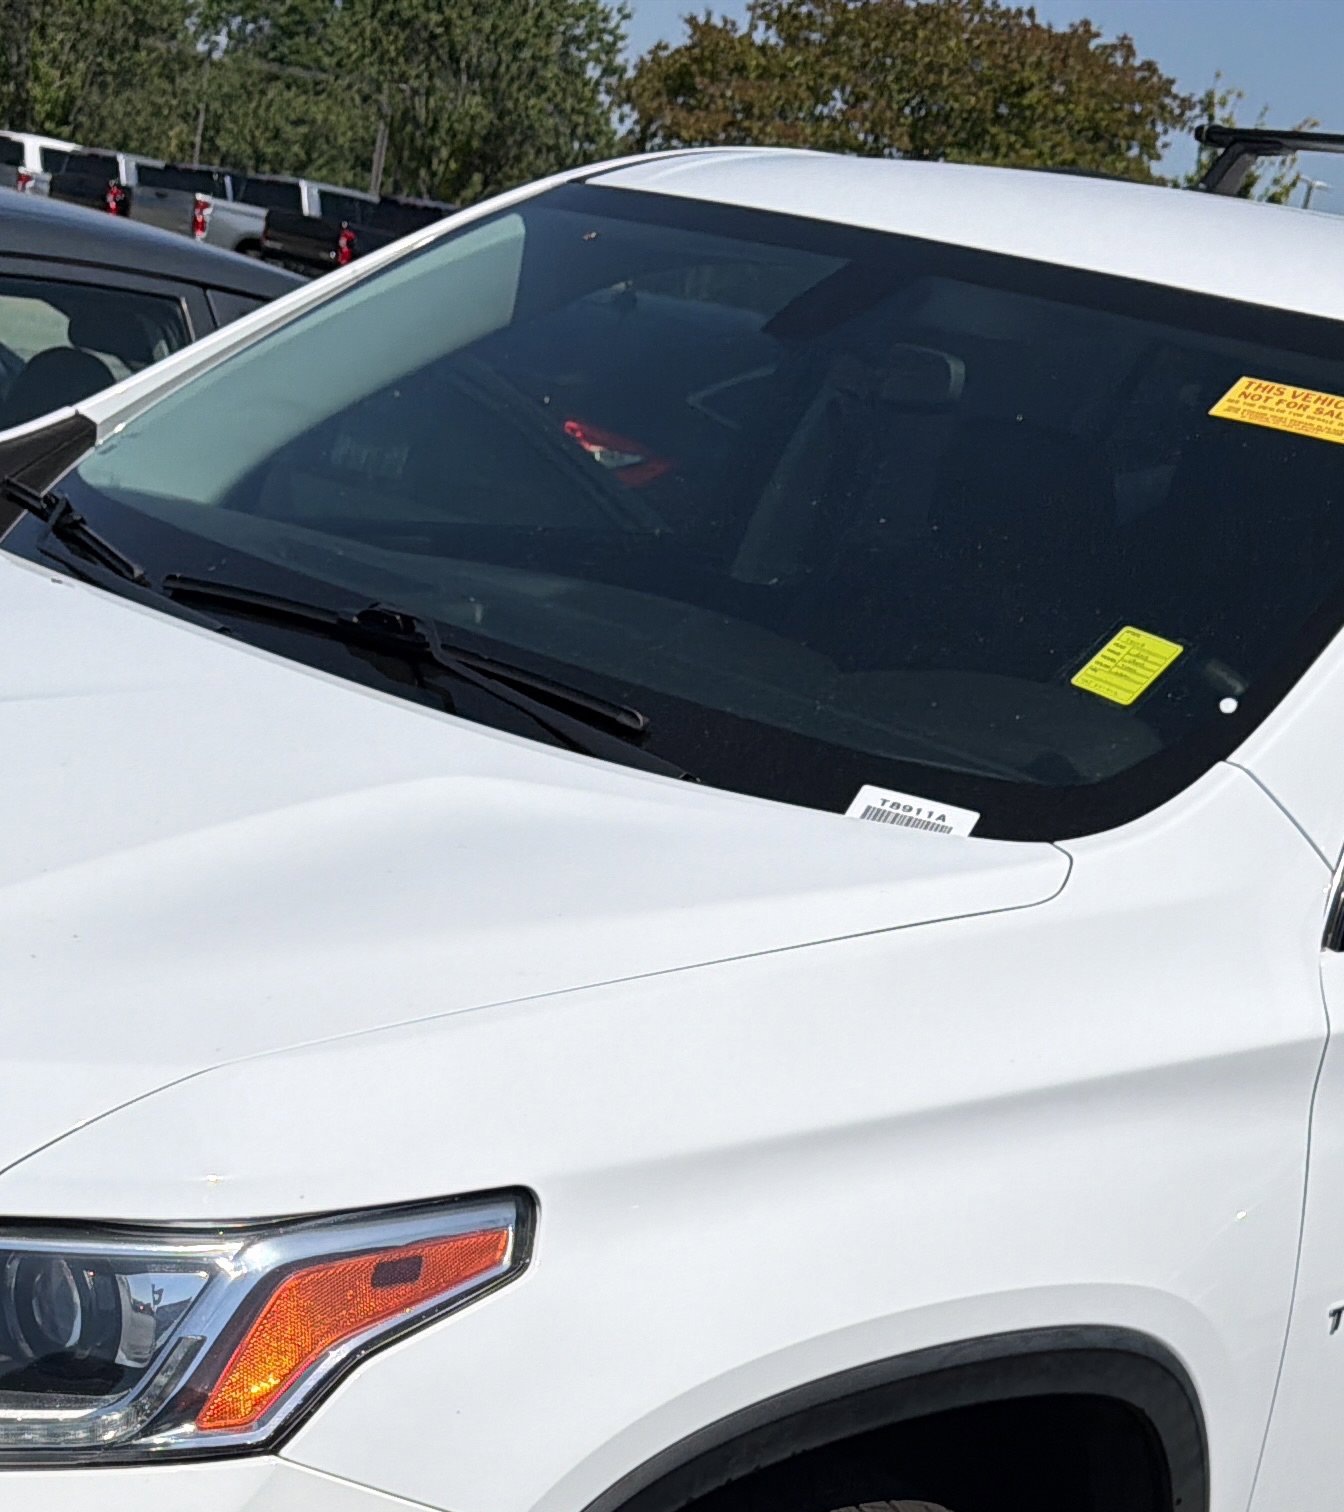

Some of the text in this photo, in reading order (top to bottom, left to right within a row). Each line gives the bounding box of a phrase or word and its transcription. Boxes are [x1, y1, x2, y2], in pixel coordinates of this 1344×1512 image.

[1245, 381, 1287, 396] THIS
[1238, 391, 1273, 403] NOT
[1275, 399, 1310, 411] FOR
[880, 798, 947, 822] T8911A
